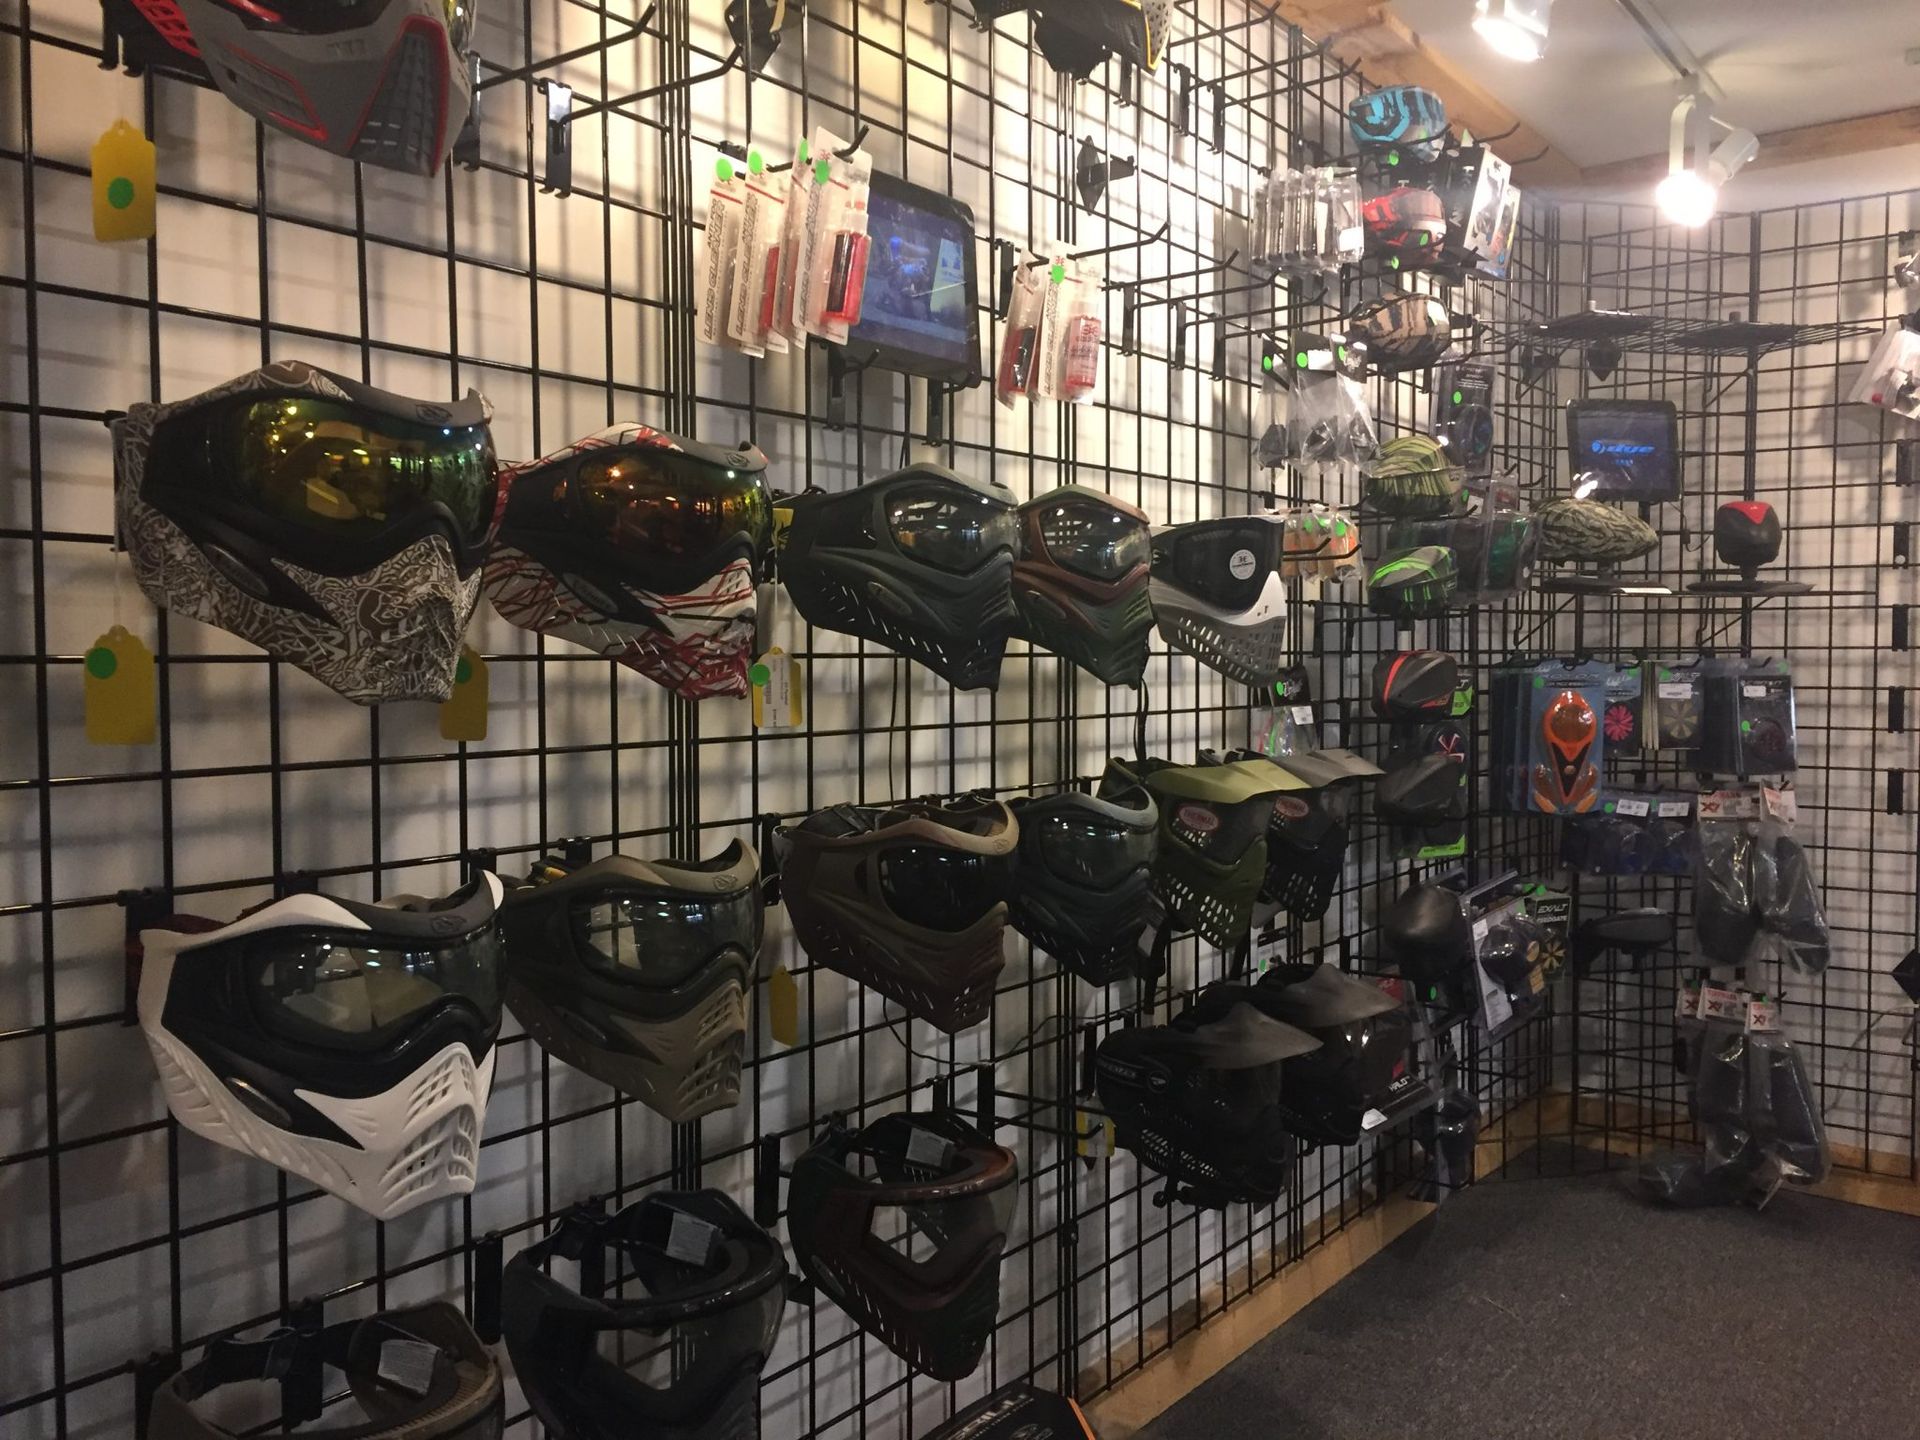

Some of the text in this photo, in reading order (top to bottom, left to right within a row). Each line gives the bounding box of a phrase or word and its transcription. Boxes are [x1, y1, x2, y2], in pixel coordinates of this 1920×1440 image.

[708, 200, 726, 287] CLEANER
[703, 286, 715, 341] LENS
[735, 282, 747, 337] LENS
[1537, 903, 1569, 914] EXALT
